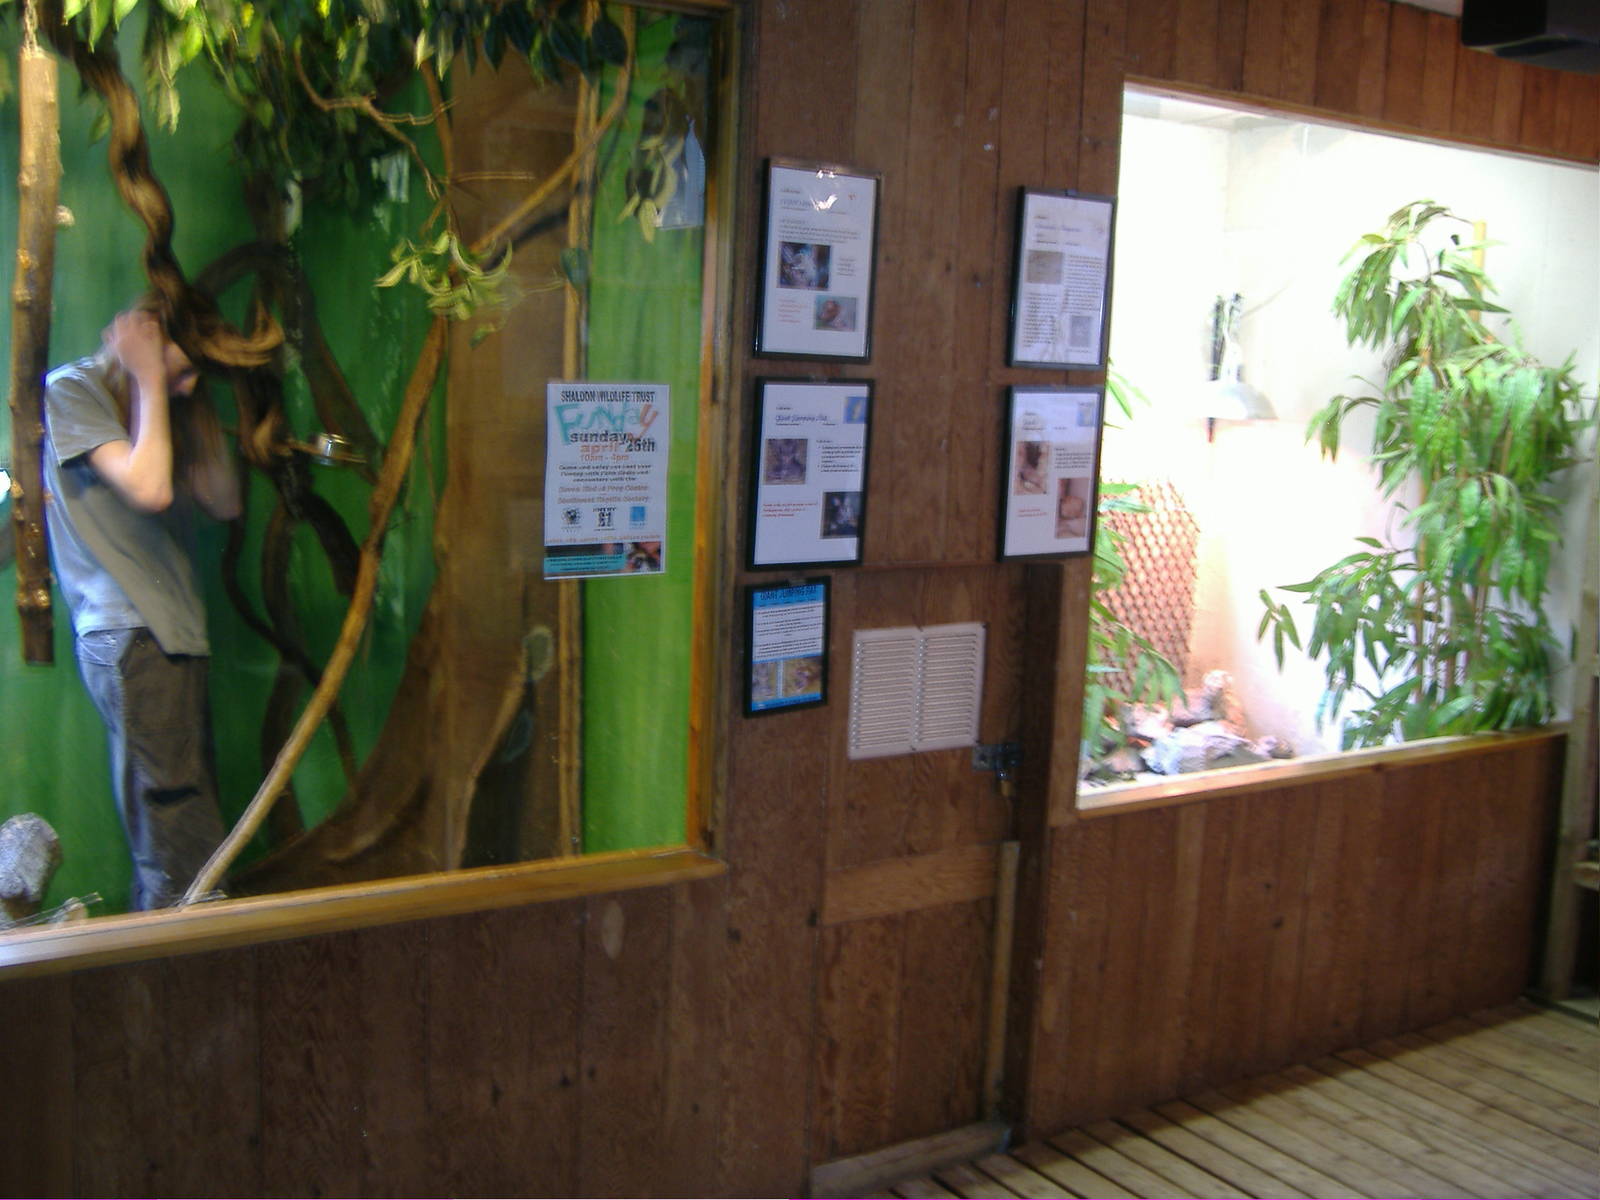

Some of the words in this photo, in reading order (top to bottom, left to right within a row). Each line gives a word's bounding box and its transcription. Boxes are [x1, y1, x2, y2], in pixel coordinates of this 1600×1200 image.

[560, 391, 596, 402] SHALDON
[597, 391, 630, 402] WILDLIFE
[632, 391, 656, 403] TRUST
[580, 443, 617, 455] april
